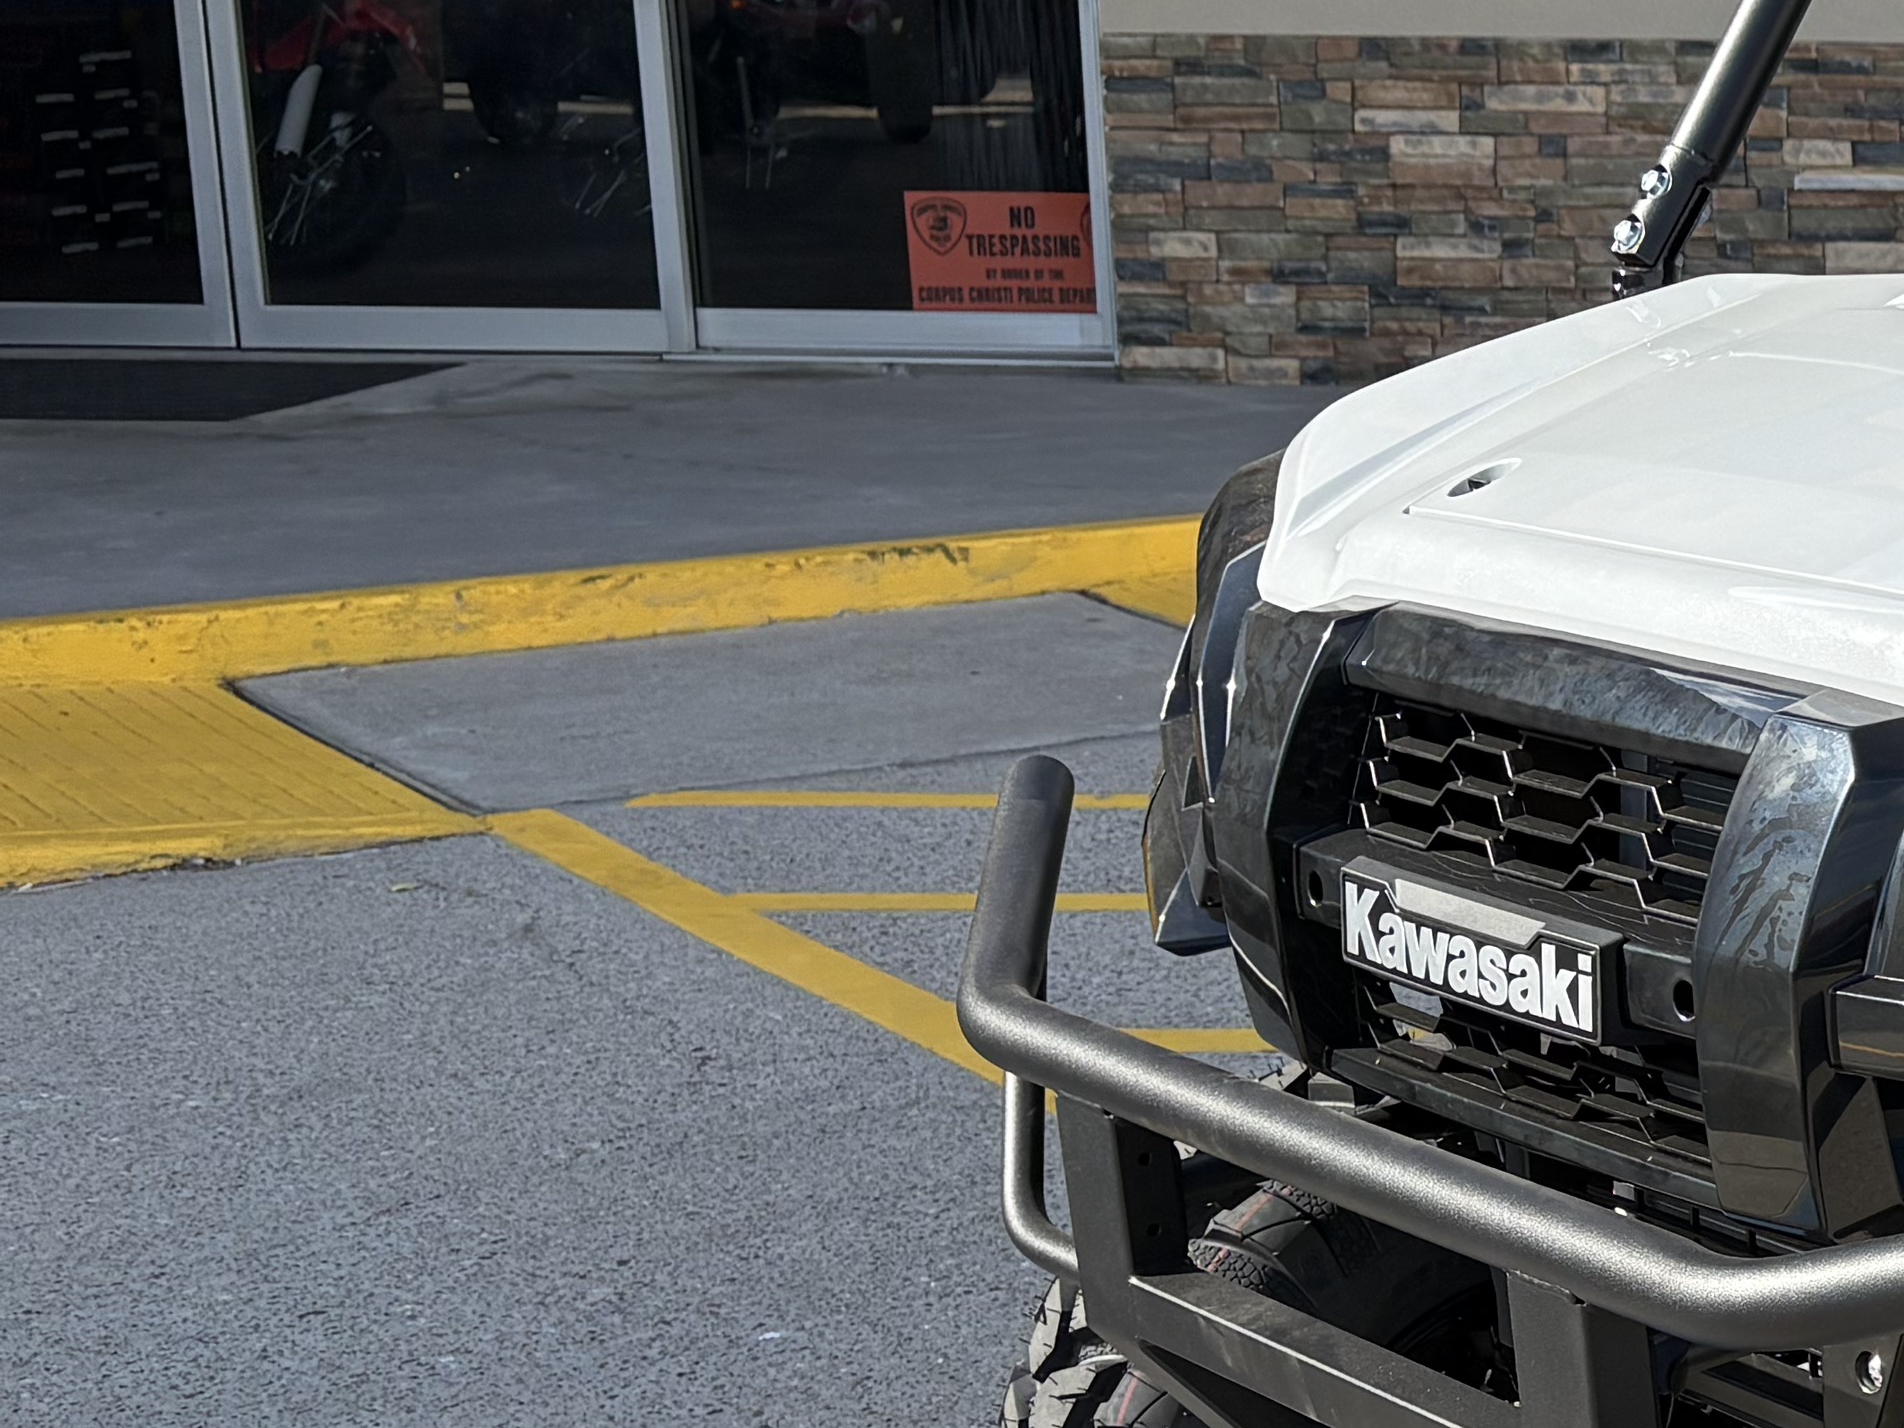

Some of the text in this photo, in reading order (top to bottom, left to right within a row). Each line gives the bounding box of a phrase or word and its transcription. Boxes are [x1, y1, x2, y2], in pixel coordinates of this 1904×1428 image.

[1008, 205, 1036, 230] NO
[966, 234, 1082, 259] TRESPASSING
[918, 286, 964, 304] CORPUS
[968, 287, 1014, 304] CHRISTI
[1018, 287, 1055, 305] POLICE
[1344, 880, 1595, 1035] Kawasaki
